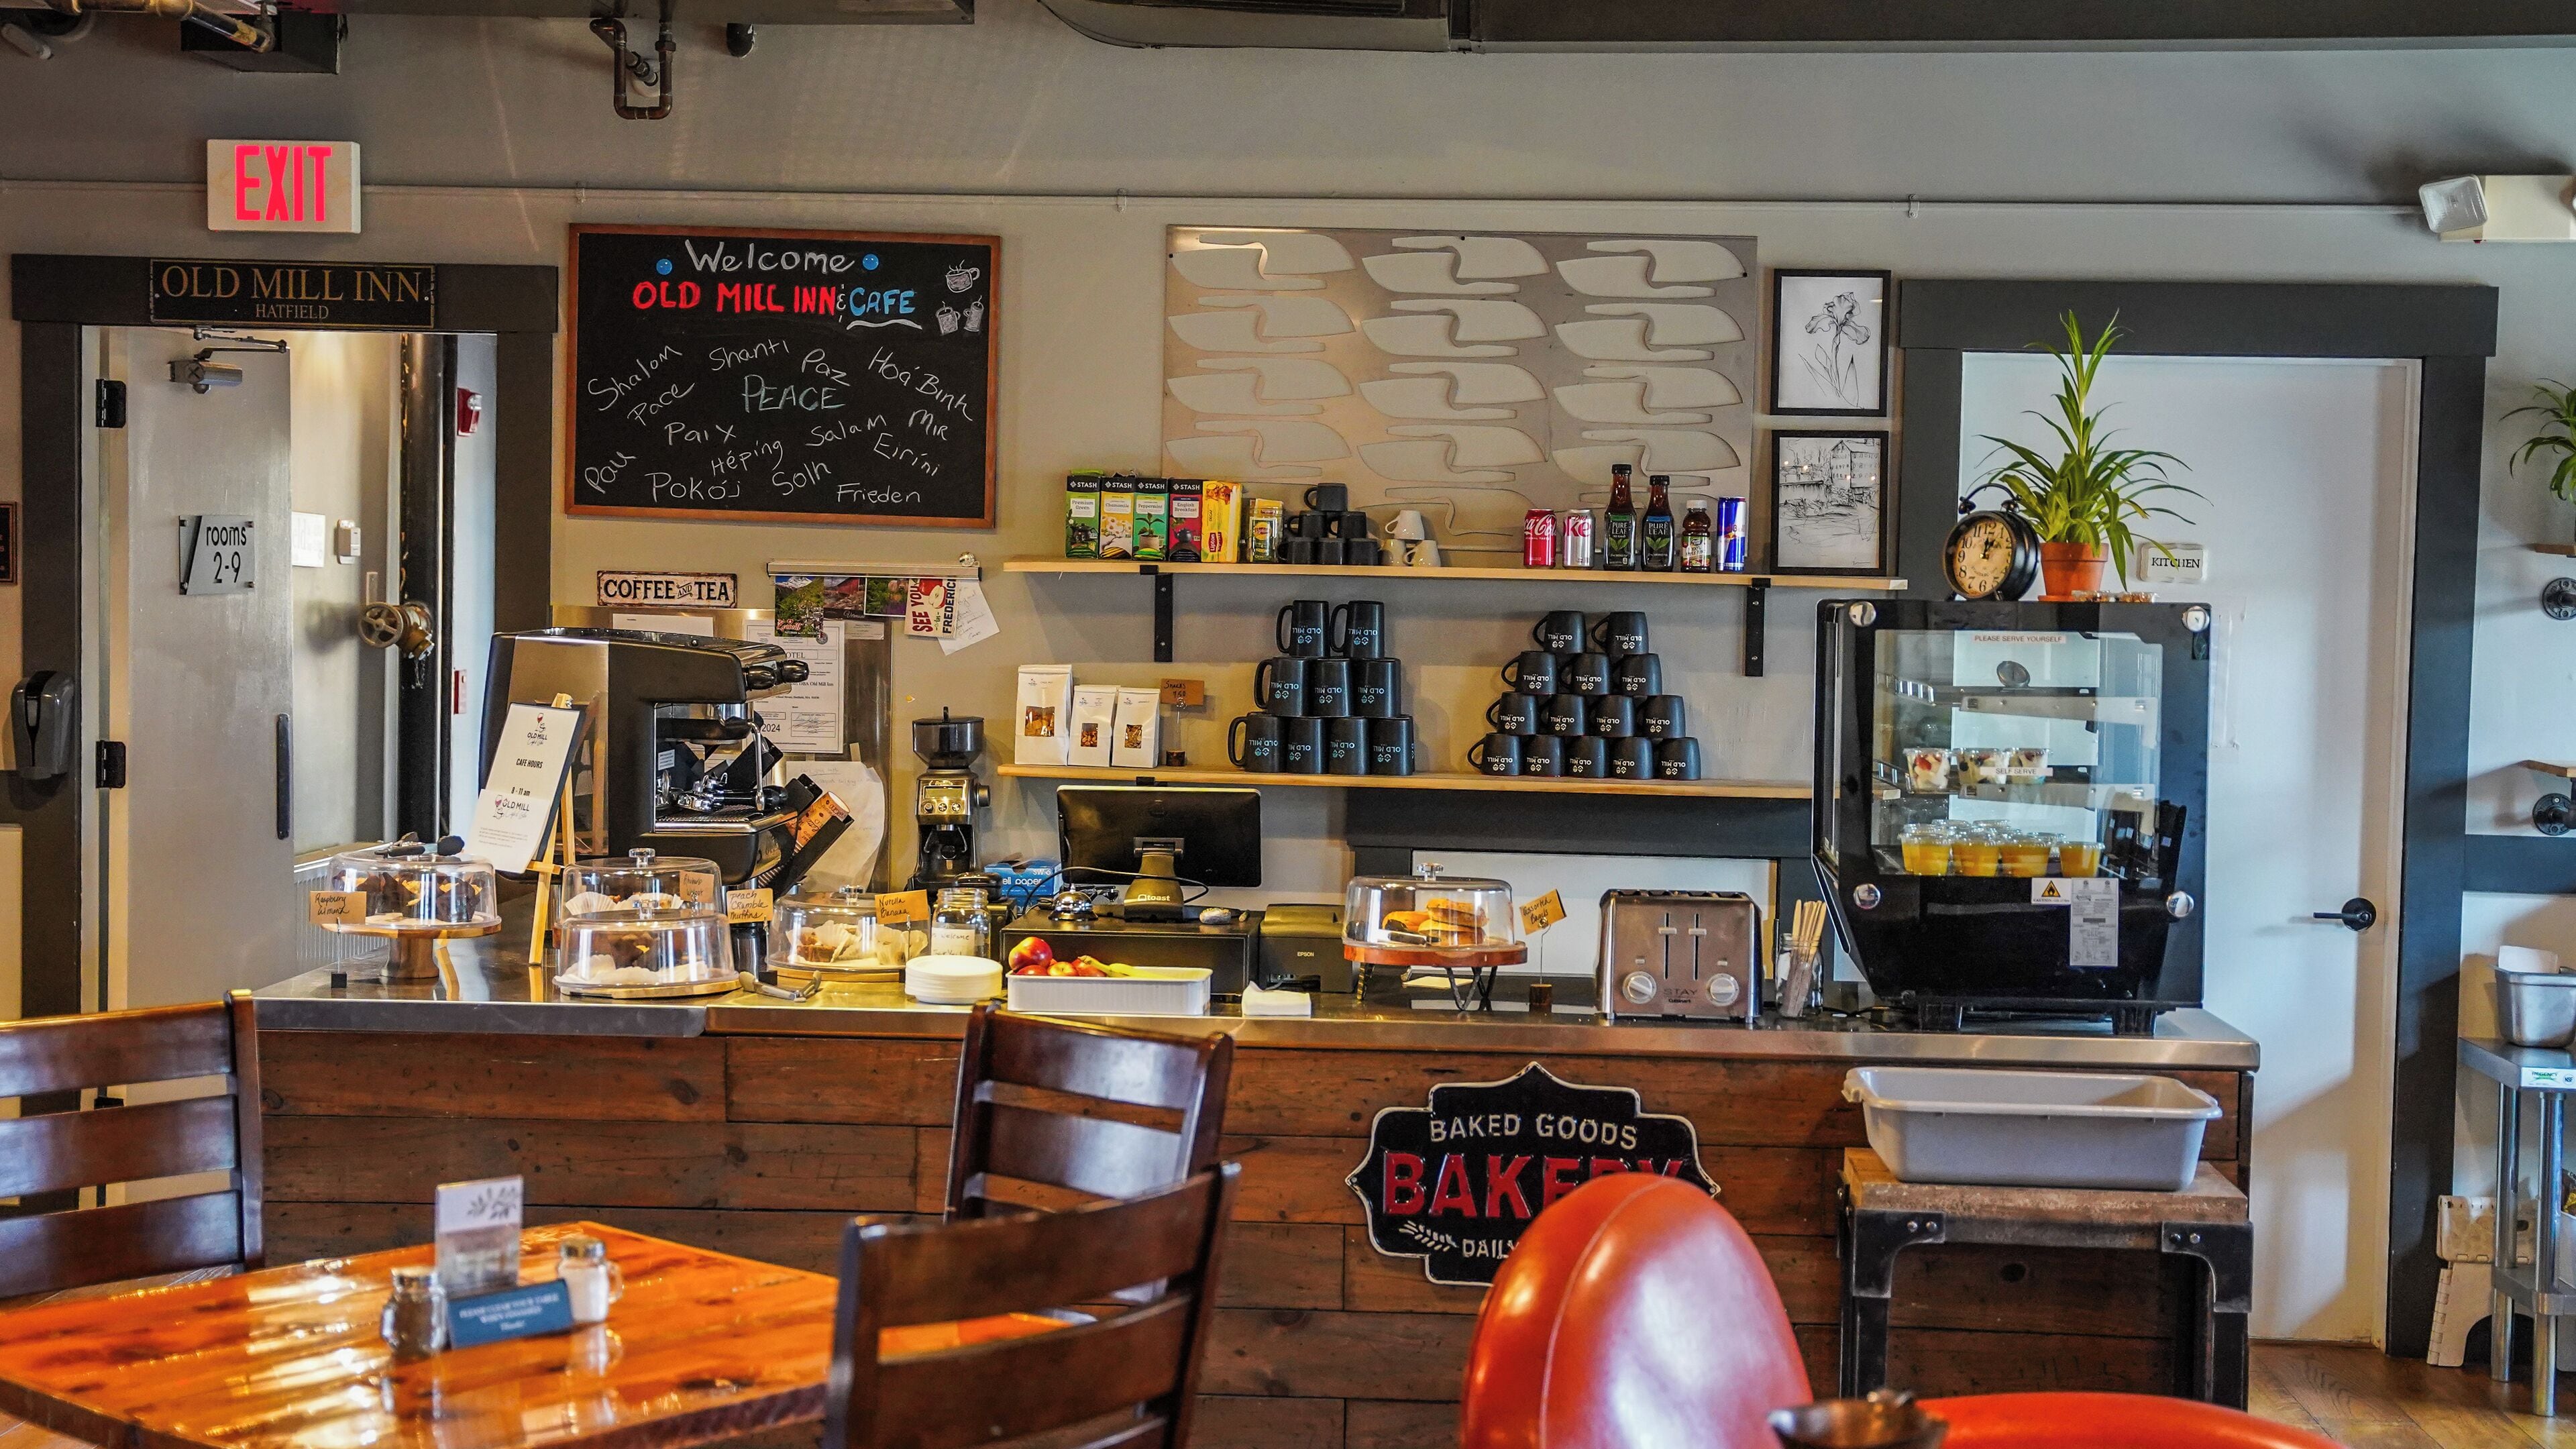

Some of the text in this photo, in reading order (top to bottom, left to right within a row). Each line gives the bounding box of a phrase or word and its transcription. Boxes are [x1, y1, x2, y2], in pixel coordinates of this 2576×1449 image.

[234, 144, 333, 222] EXIT
[684, 239, 857, 273] Welcome
[162, 265, 421, 303] OLD MILL INN
[632, 281, 702, 310] OLD
[716, 283, 786, 313] MILL
[794, 286, 837, 316] INN
[849, 287, 917, 316] CAFE
[255, 303, 329, 320] HATFIELD
[741, 374, 847, 414] PEACE
[837, 482, 921, 503] Frieden
[205, 525, 248, 547] rooms
[212, 551, 241, 584] 2-9
[2151, 557, 2200, 568] KITCHEN
[603, 578, 729, 602] COFFEE AND TEA
[1979, 580, 1986, 592] 6
[910, 585, 934, 632] SEE YOU
[761, 723, 781, 733] 2024
[516, 758, 543, 769] CAFE HOURS
[511, 786, 515, 794] 8
[502, 800, 530, 812] OLD MILL
[1002, 876, 1042, 886] eli paper
[1663, 987, 1698, 996] STAY
[1429, 1113, 1640, 1150] BAKED GOODS
[1382, 1151, 1684, 1220] BAKE
